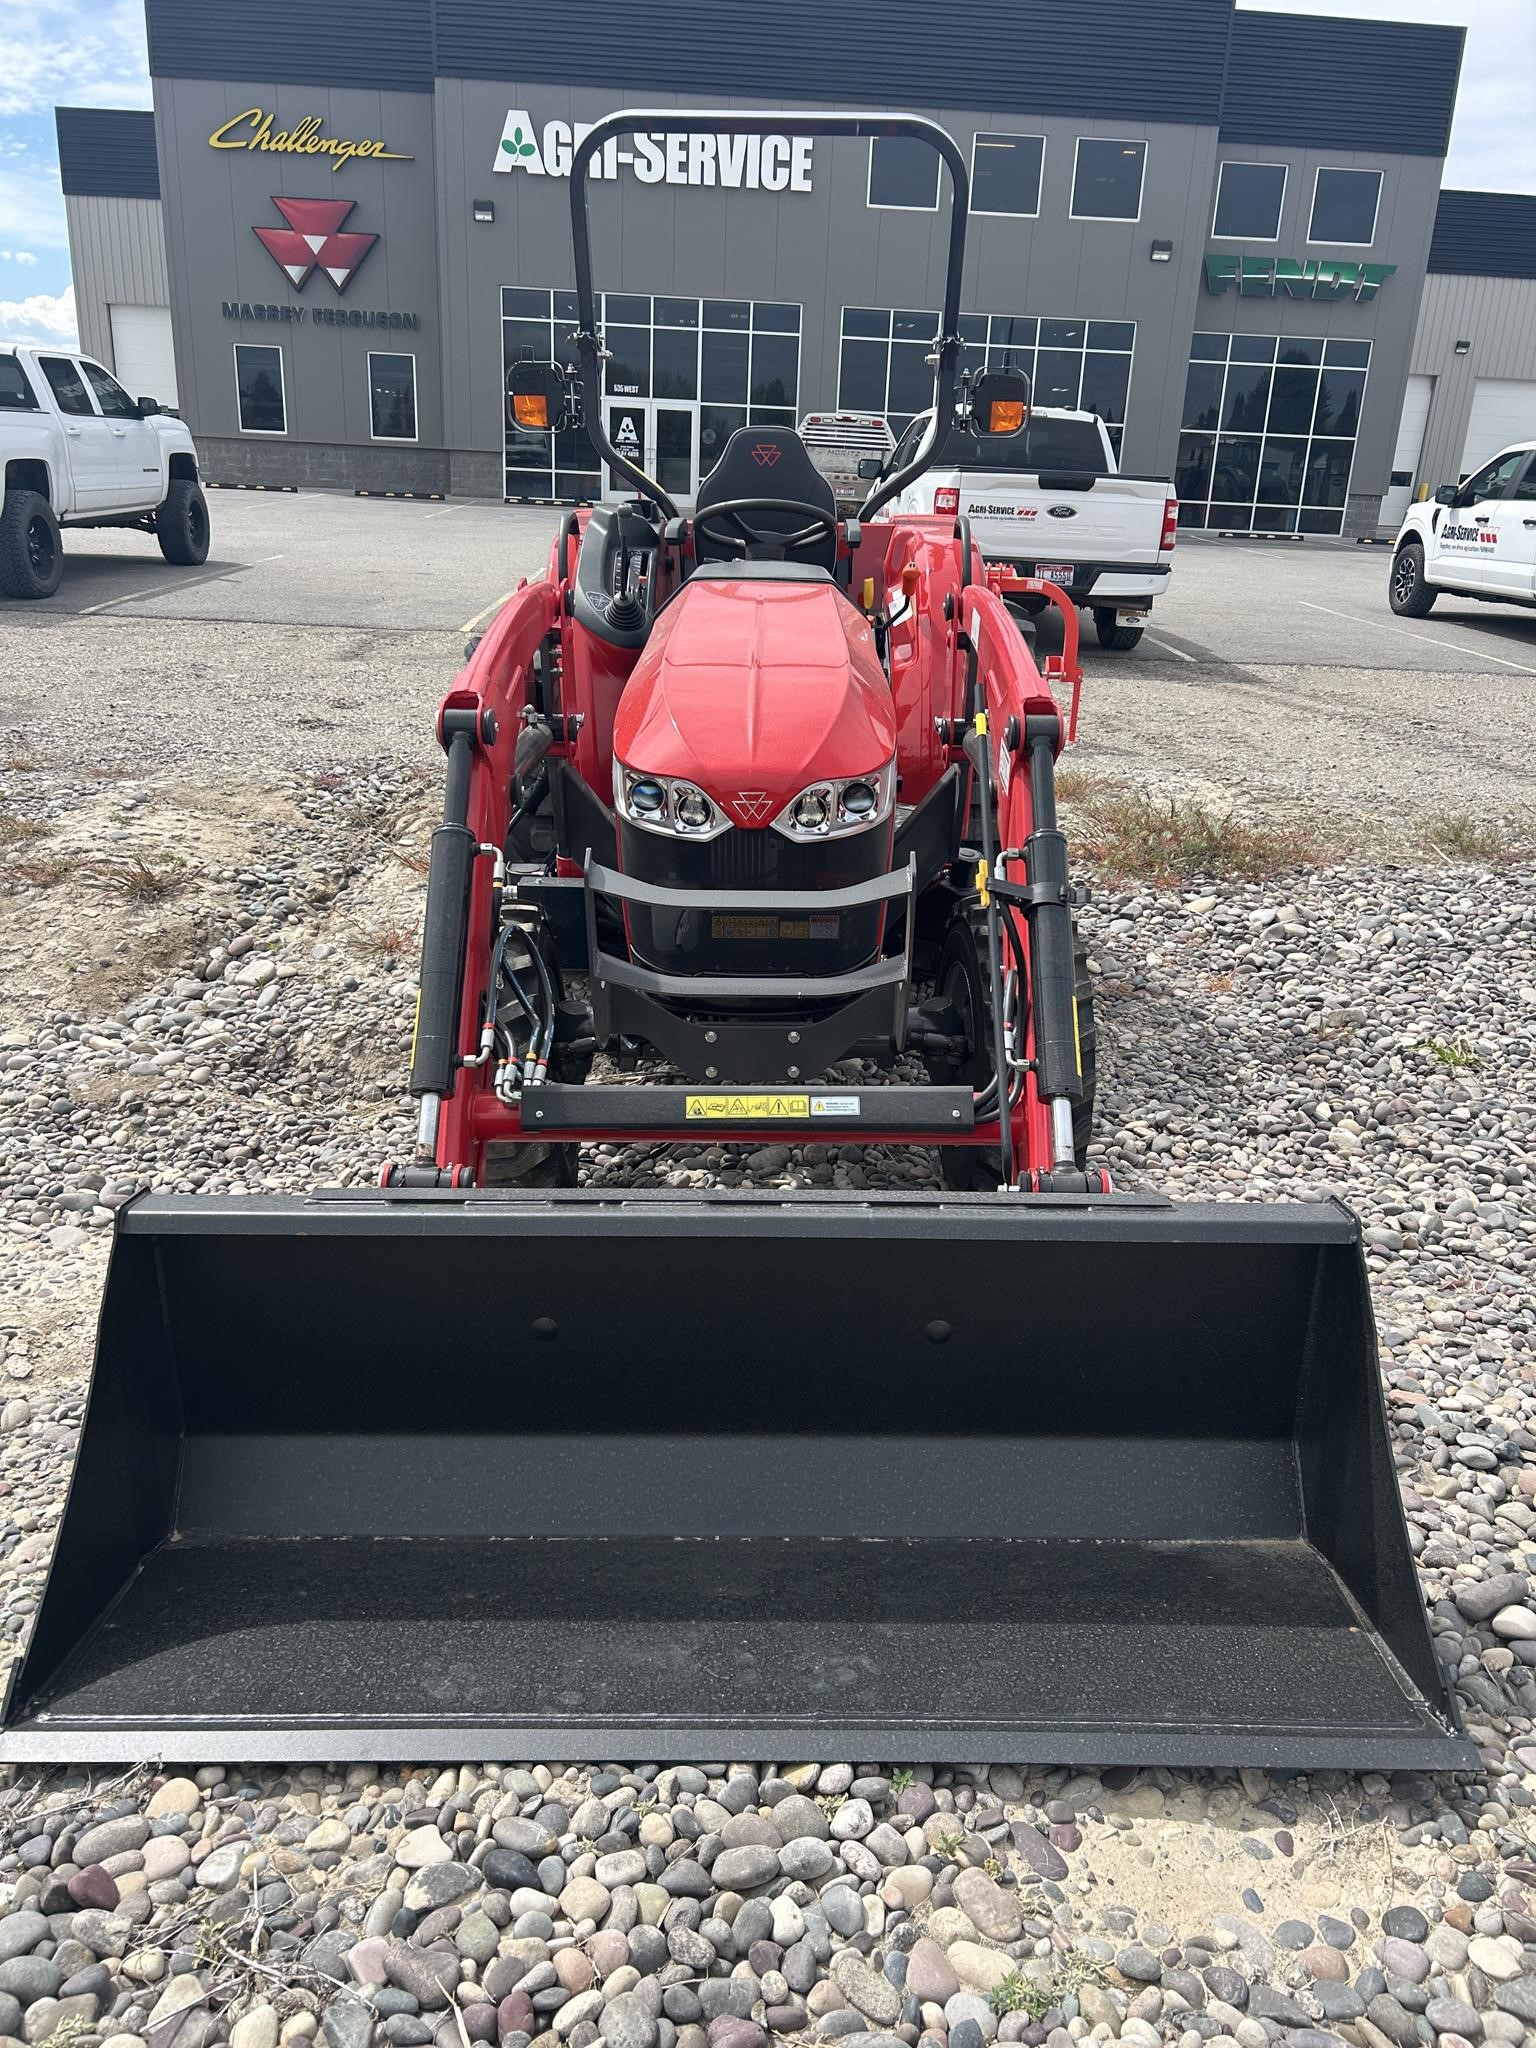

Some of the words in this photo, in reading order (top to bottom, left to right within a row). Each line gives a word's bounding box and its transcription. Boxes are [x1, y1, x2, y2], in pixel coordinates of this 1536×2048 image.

[208, 107, 415, 172] Challenger
[1206, 254, 1399, 302] FENDT
[221, 301, 304, 322] MASSEY
[311, 307, 420, 330] FERGUSON
[624, 385, 640, 394] WEST
[967, 503, 1016, 516] AGRI-SERVICE
[1441, 523, 1480, 542] AGRI-SERVICE
